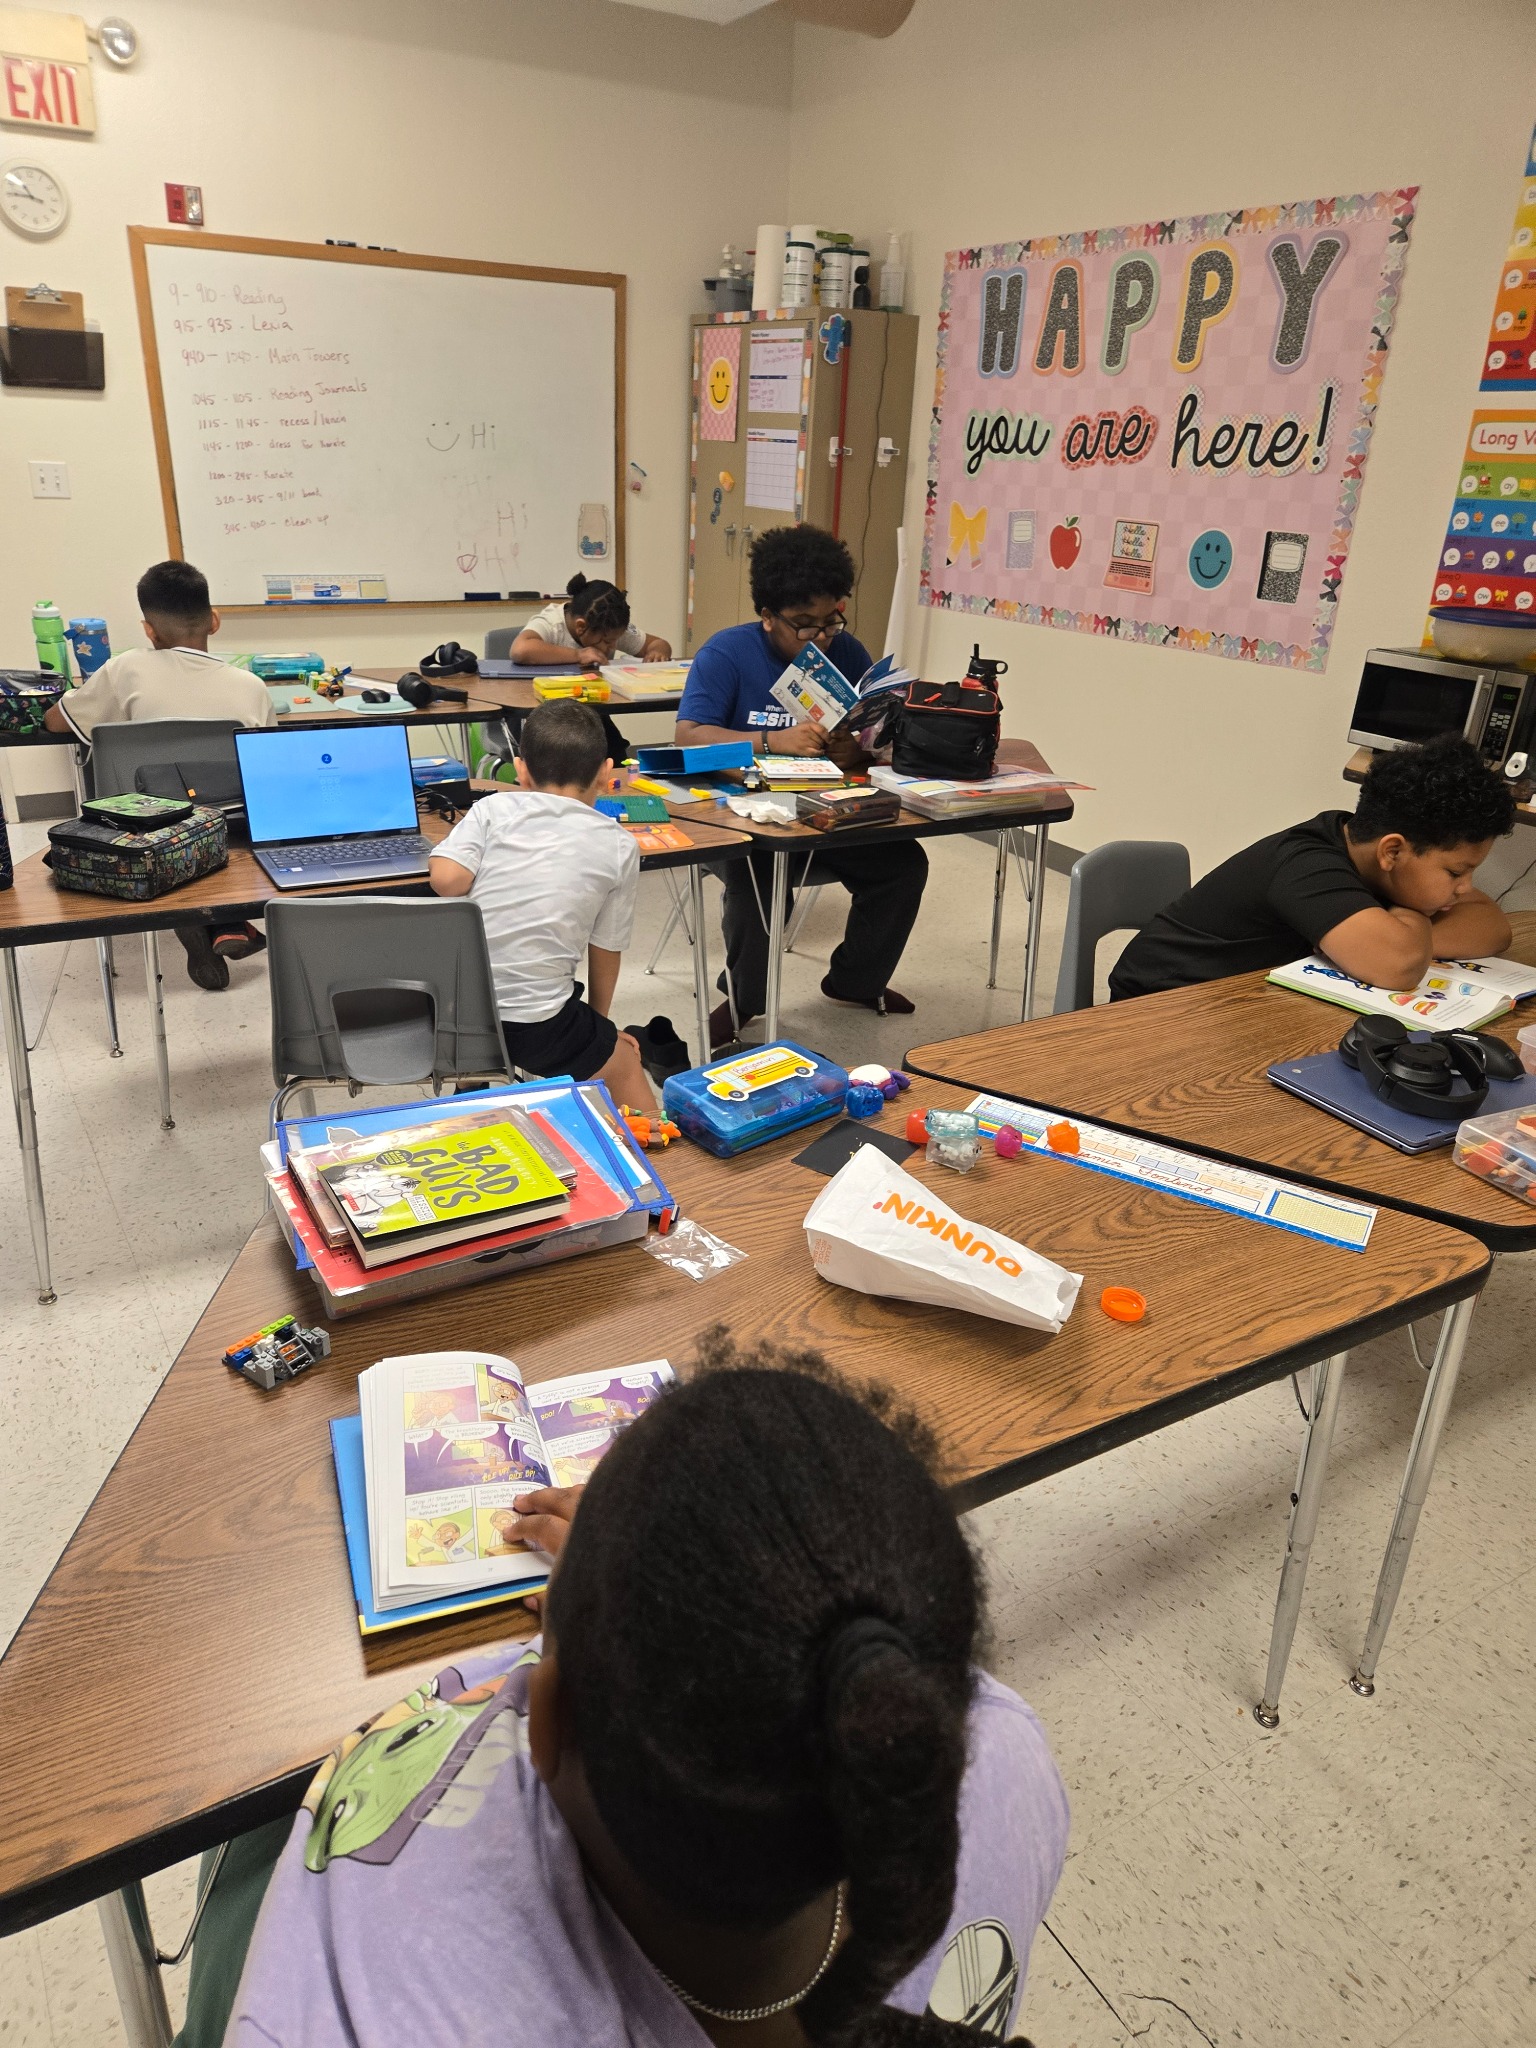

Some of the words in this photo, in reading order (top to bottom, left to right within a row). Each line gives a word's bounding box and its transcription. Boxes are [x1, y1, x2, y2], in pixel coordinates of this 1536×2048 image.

[4, 57, 79, 125] EXIT
[233, 285, 286, 315] Reading
[979, 235, 1347, 377] HAPPY
[252, 315, 293, 331] Lexia
[315, 377, 368, 396] Journals
[471, 422, 496, 450] Hi
[967, 413, 1050, 473] you
[1066, 412, 1152, 461] are
[1172, 387, 1333, 468] here!
[1479, 430, 1518, 450] Long
[1504, 482, 1515, 492] ay
[497, 502, 528, 537] Hi
[1519, 597, 1530, 605] oe
[406, 1148, 482, 1209] GUYS
[451, 1144, 520, 1195] BAD
[541, 1409, 555, 1421] BOO!
